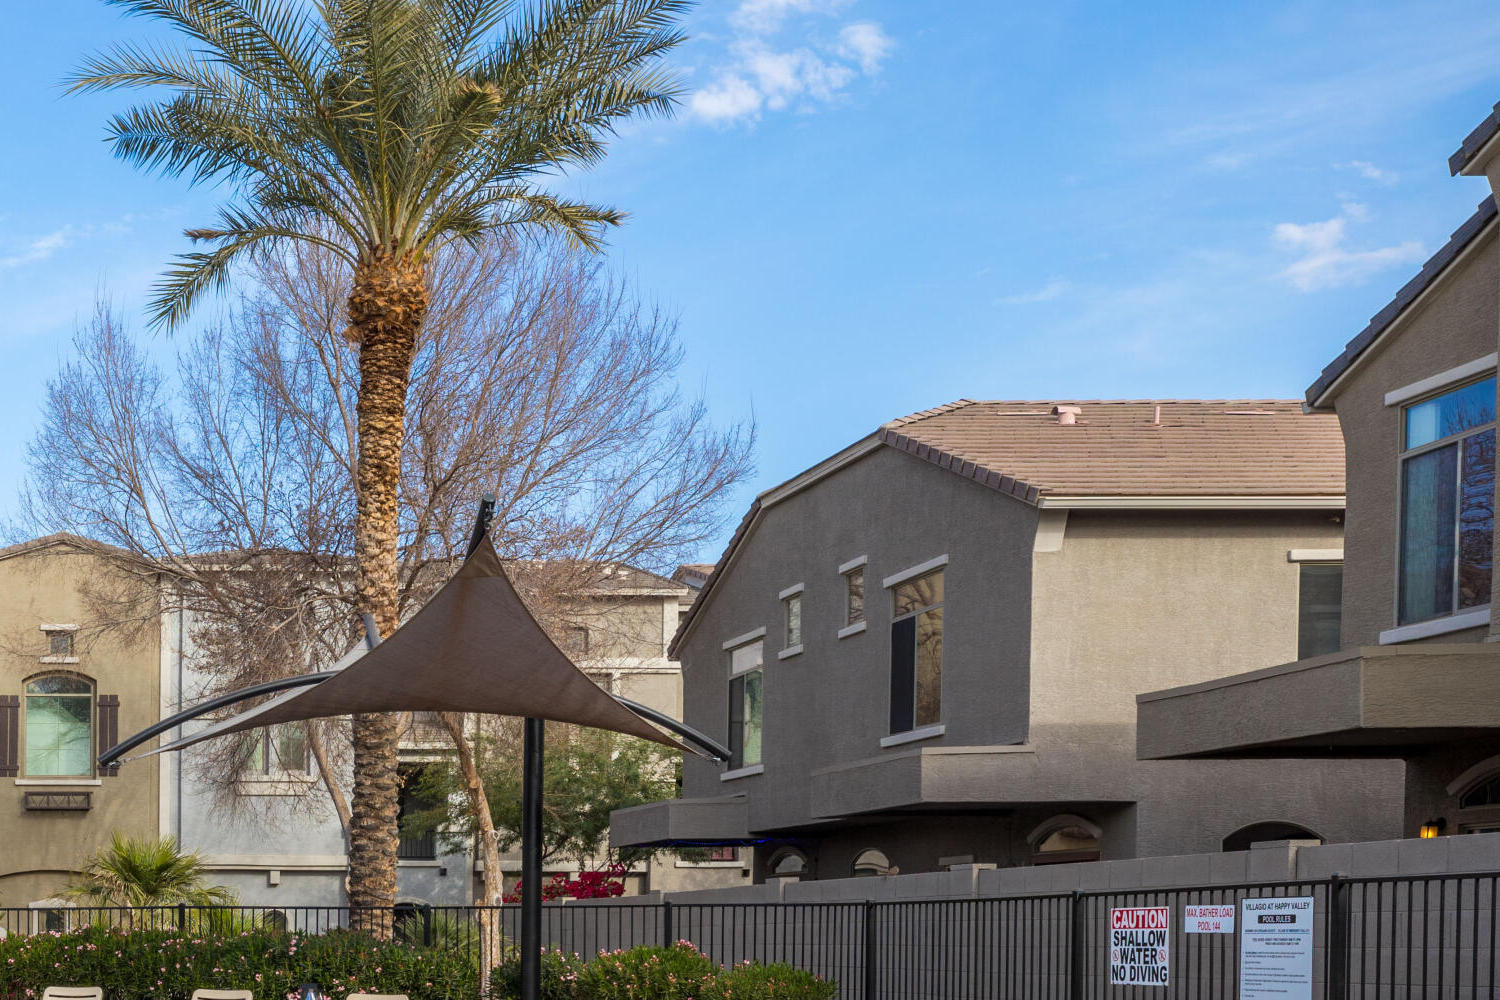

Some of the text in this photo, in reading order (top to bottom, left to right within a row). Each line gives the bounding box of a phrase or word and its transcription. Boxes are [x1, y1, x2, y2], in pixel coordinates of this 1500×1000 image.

[1199, 908, 1218, 918] BATHER
[1219, 908, 1233, 918] LOAD
[1245, 902, 1311, 911] VILLAGIO AT HAPPY VALLEY
[1113, 909, 1167, 928] CAUTION
[1262, 915, 1291, 923] POOL RULES
[1197, 921, 1221, 931] POOL 144
[1113, 930, 1166, 947] SHALLOW
[1120, 948, 1158, 965] WATER
[1112, 965, 1168, 983] NO DIVING
